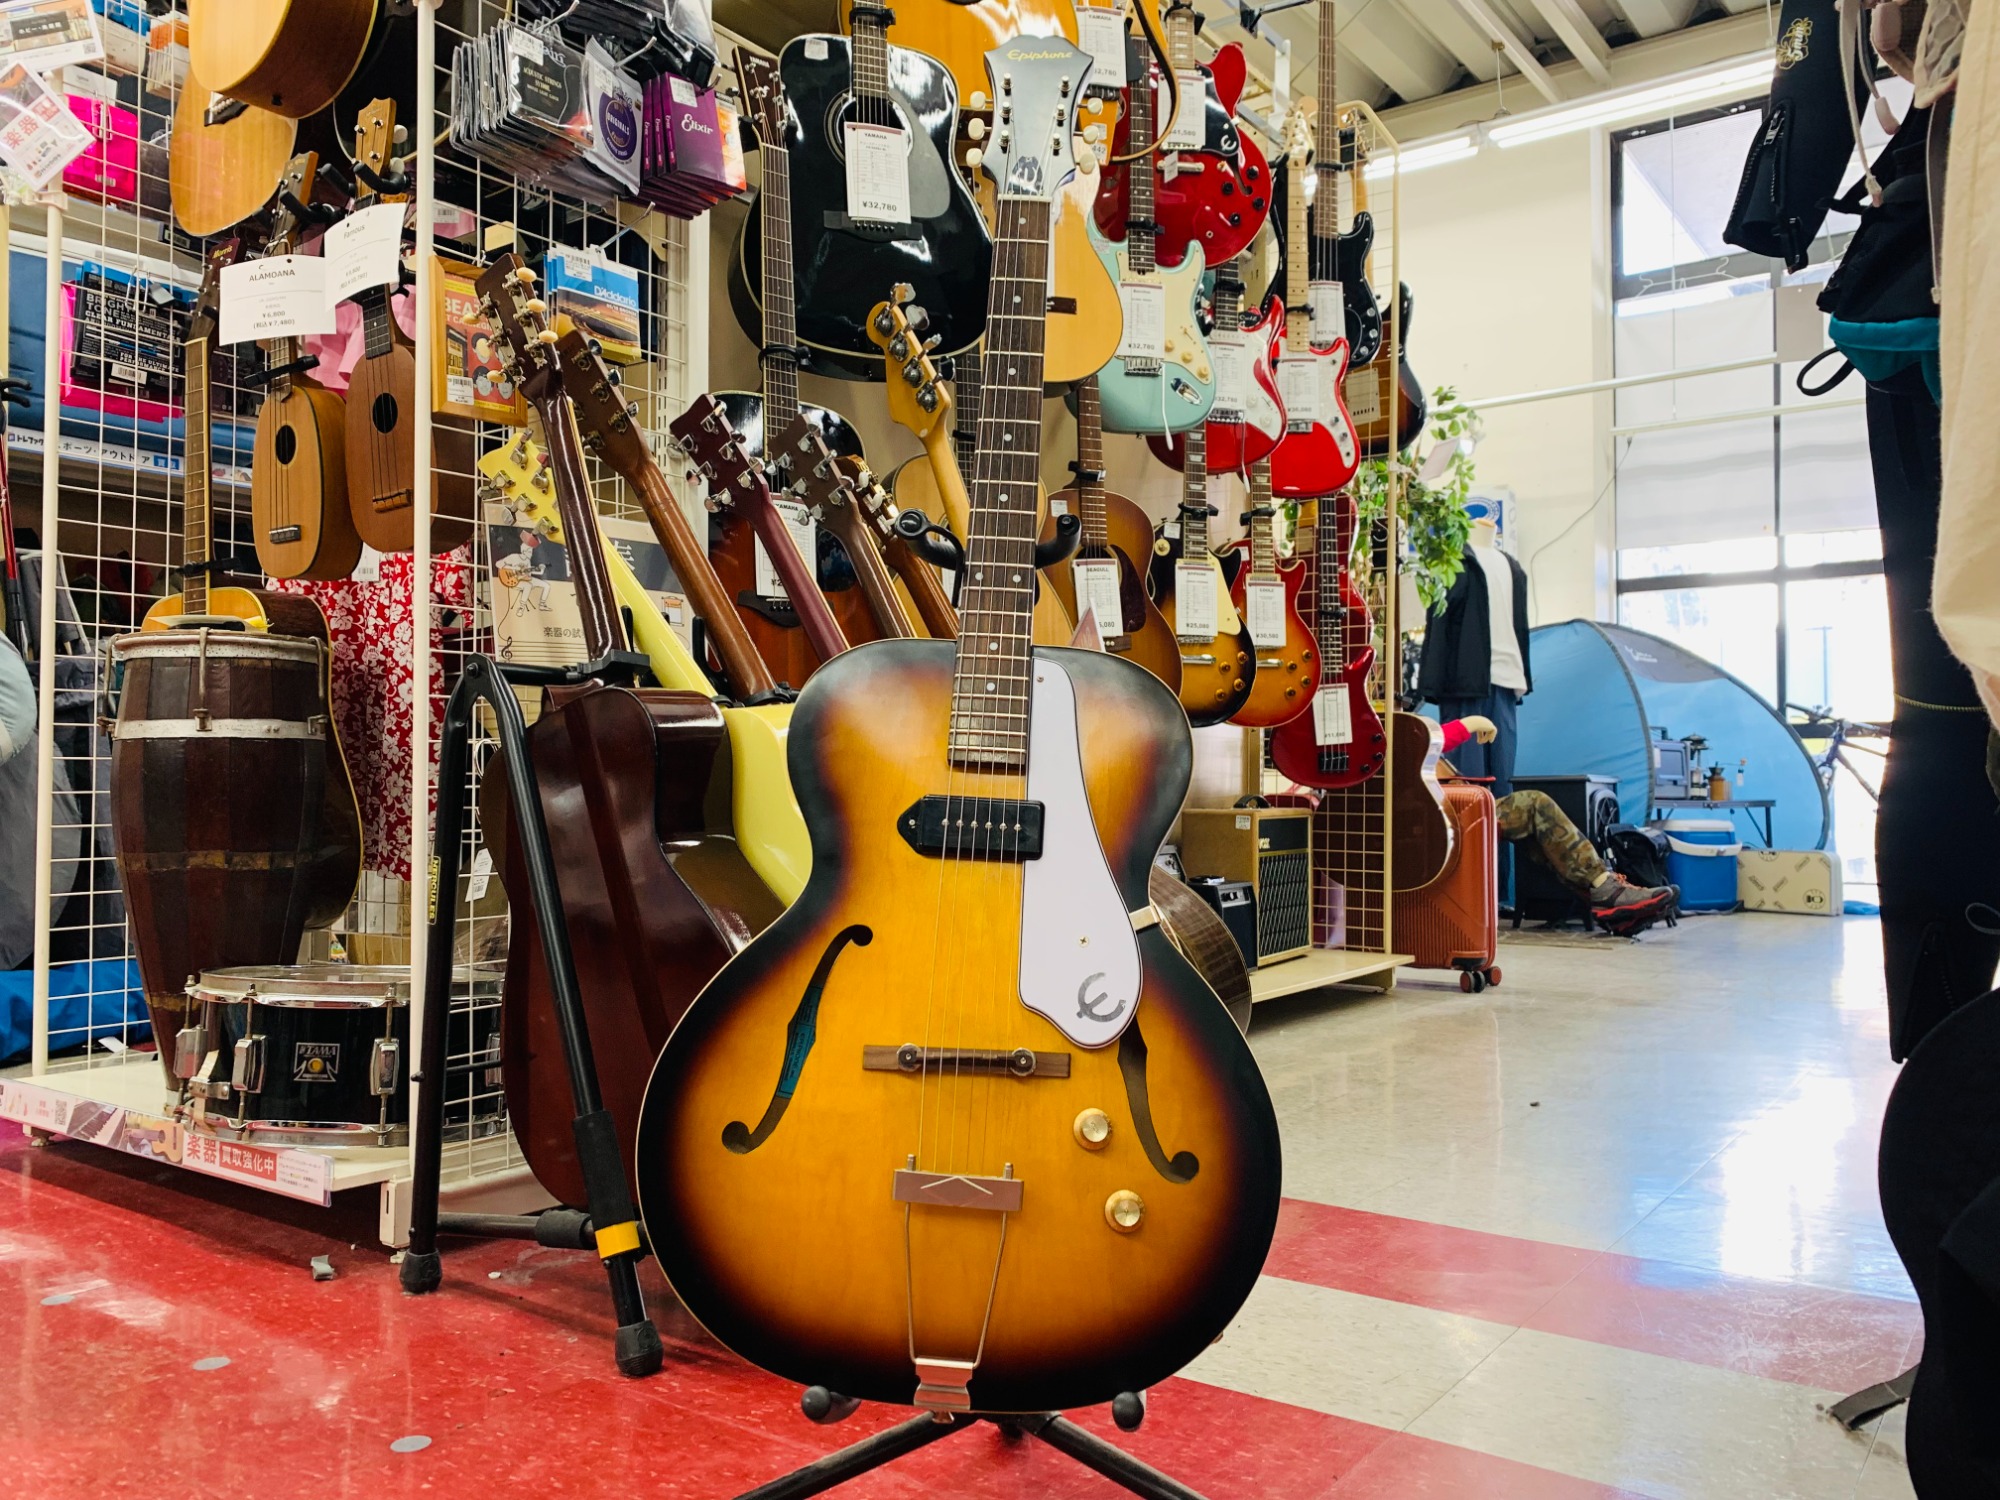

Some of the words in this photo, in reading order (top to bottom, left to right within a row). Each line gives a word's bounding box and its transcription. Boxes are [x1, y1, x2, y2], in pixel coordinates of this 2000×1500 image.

[1006, 49, 1073, 62] Epiphone
[681, 113, 714, 135] Elixir
[862, 201, 897, 212] ¥32,780
[343, 224, 365, 240] Famous
[248, 268, 296, 282] ALAMOANA
[593, 285, 637, 308] D'Addario
[775, 503, 799, 511] YAMAHA
[543, 626, 585, 638] 楽器の試
[305, 1045, 337, 1056] TAMA
[186, 1134, 217, 1165] 楽器
[221, 1144, 274, 1175] 買取強化中
